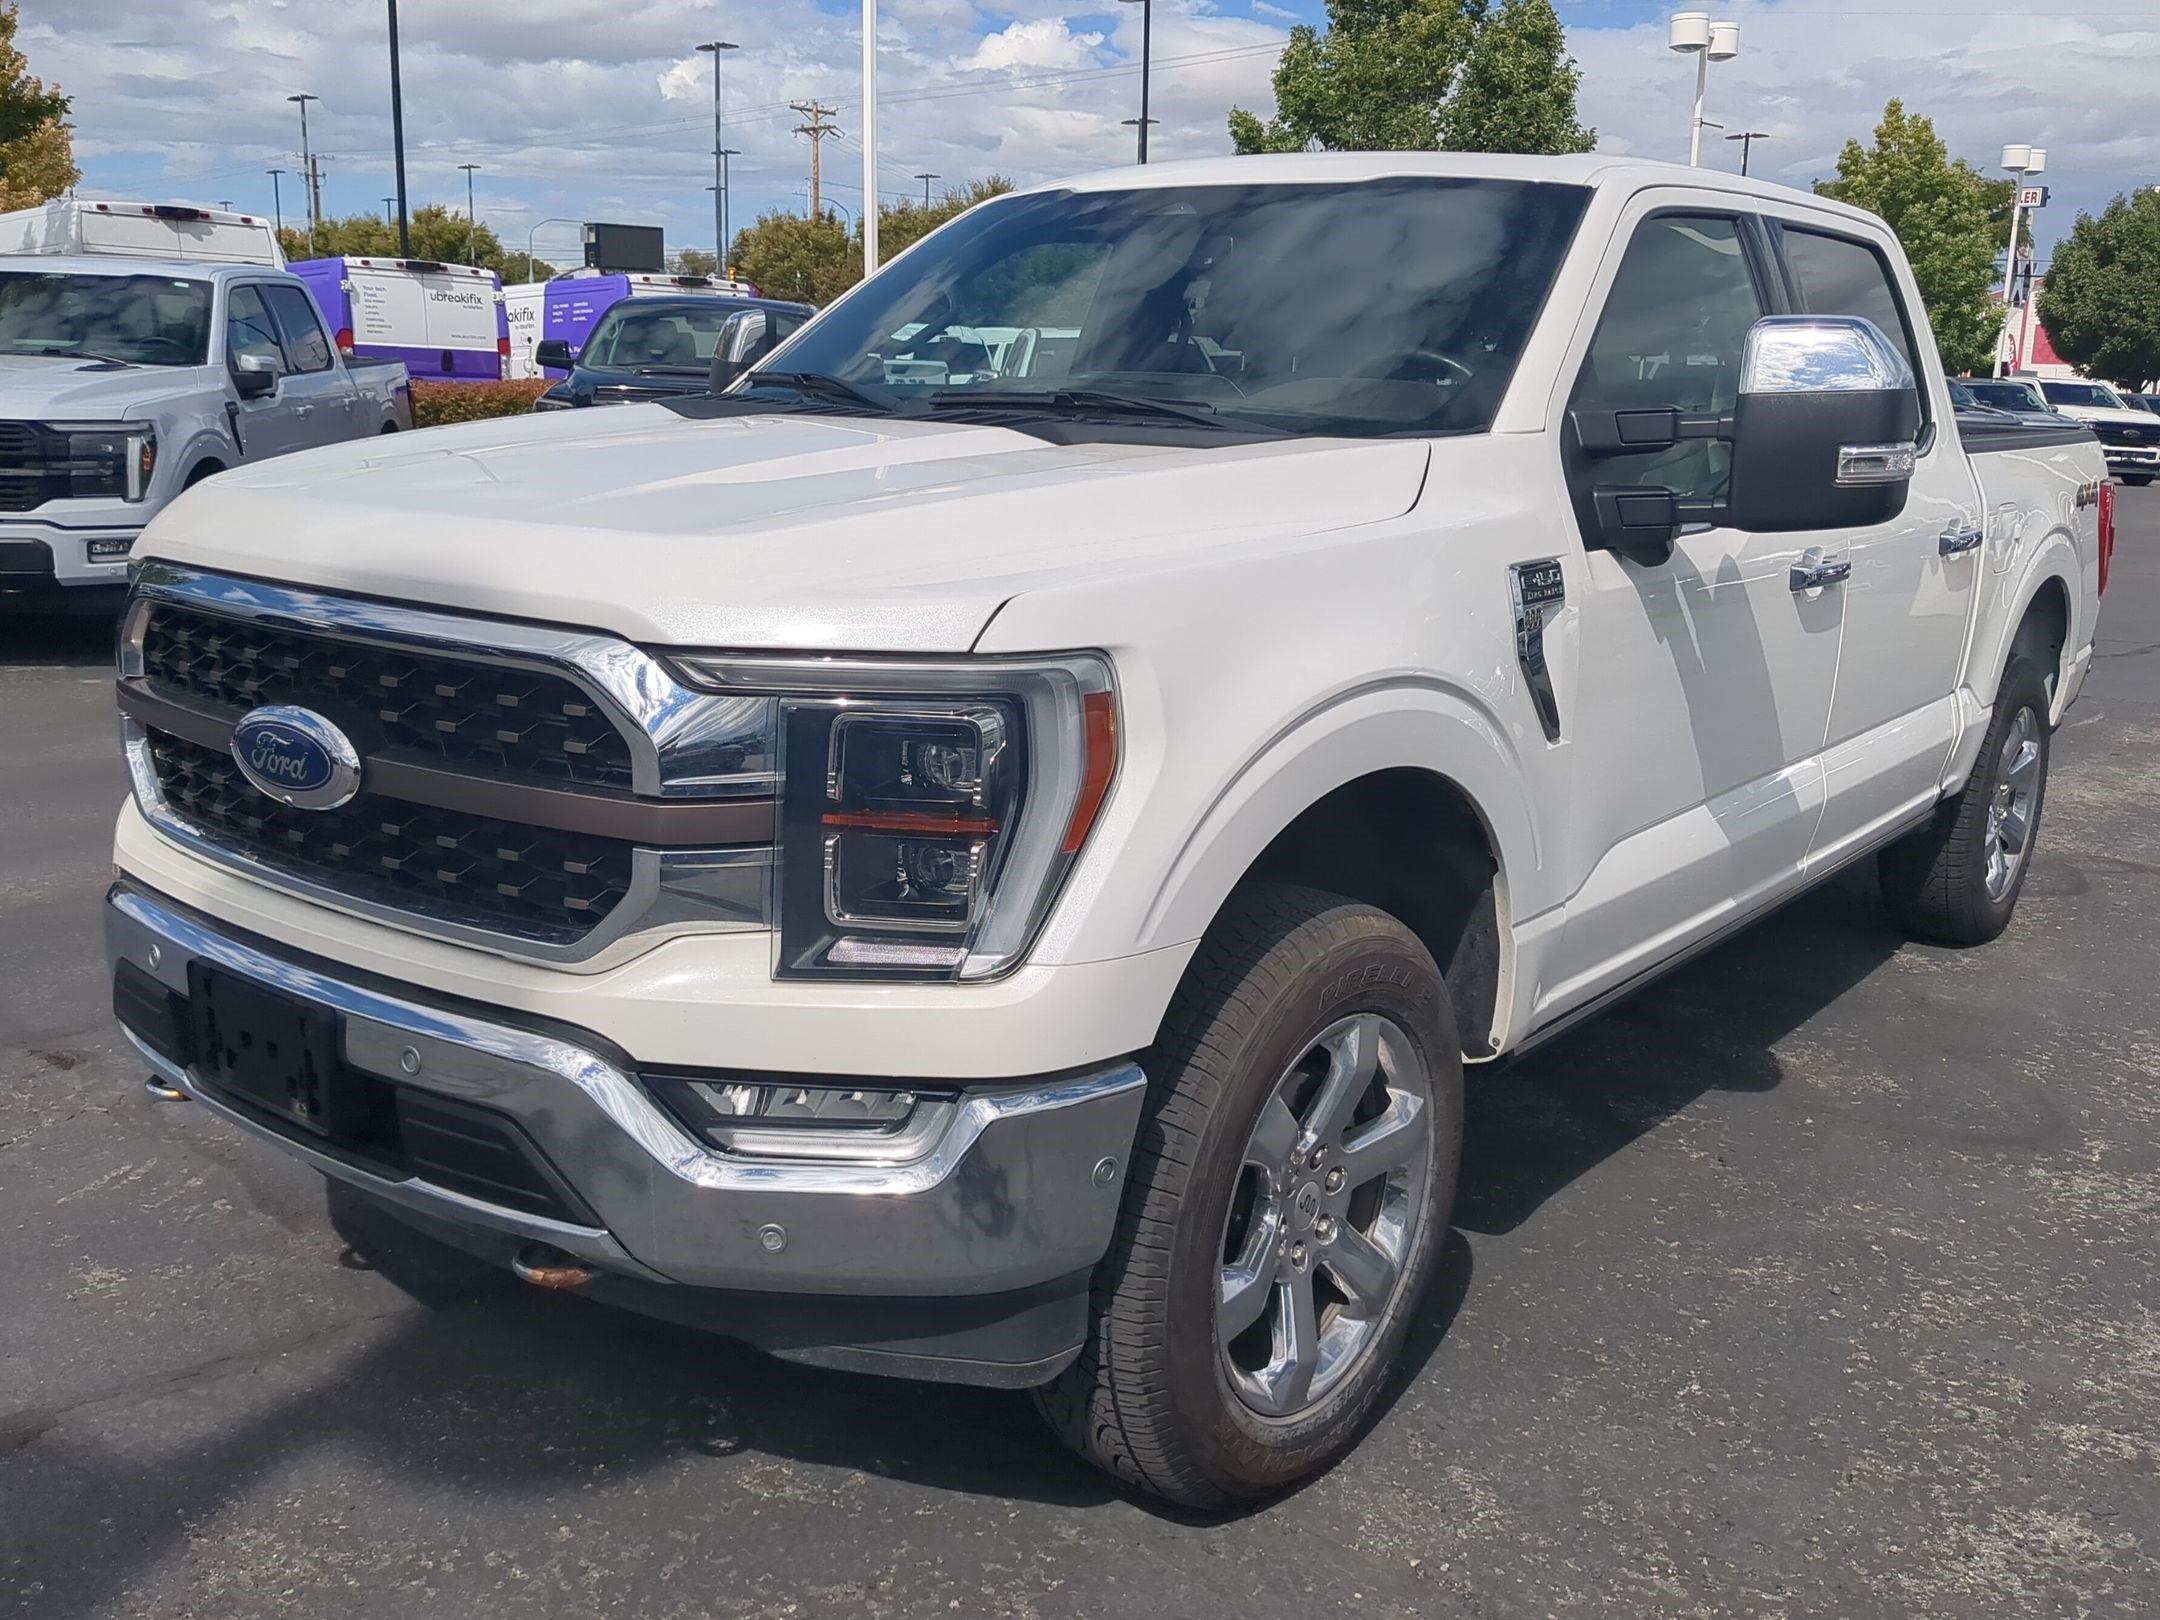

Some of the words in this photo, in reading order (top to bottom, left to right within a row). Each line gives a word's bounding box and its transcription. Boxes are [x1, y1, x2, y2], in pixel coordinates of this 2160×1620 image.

[2020, 191, 2038, 204] ER
[430, 291, 482, 305] ubreakifix
[251, 731, 308, 780] Ford
[1318, 963, 1413, 1010] PIRELLI
